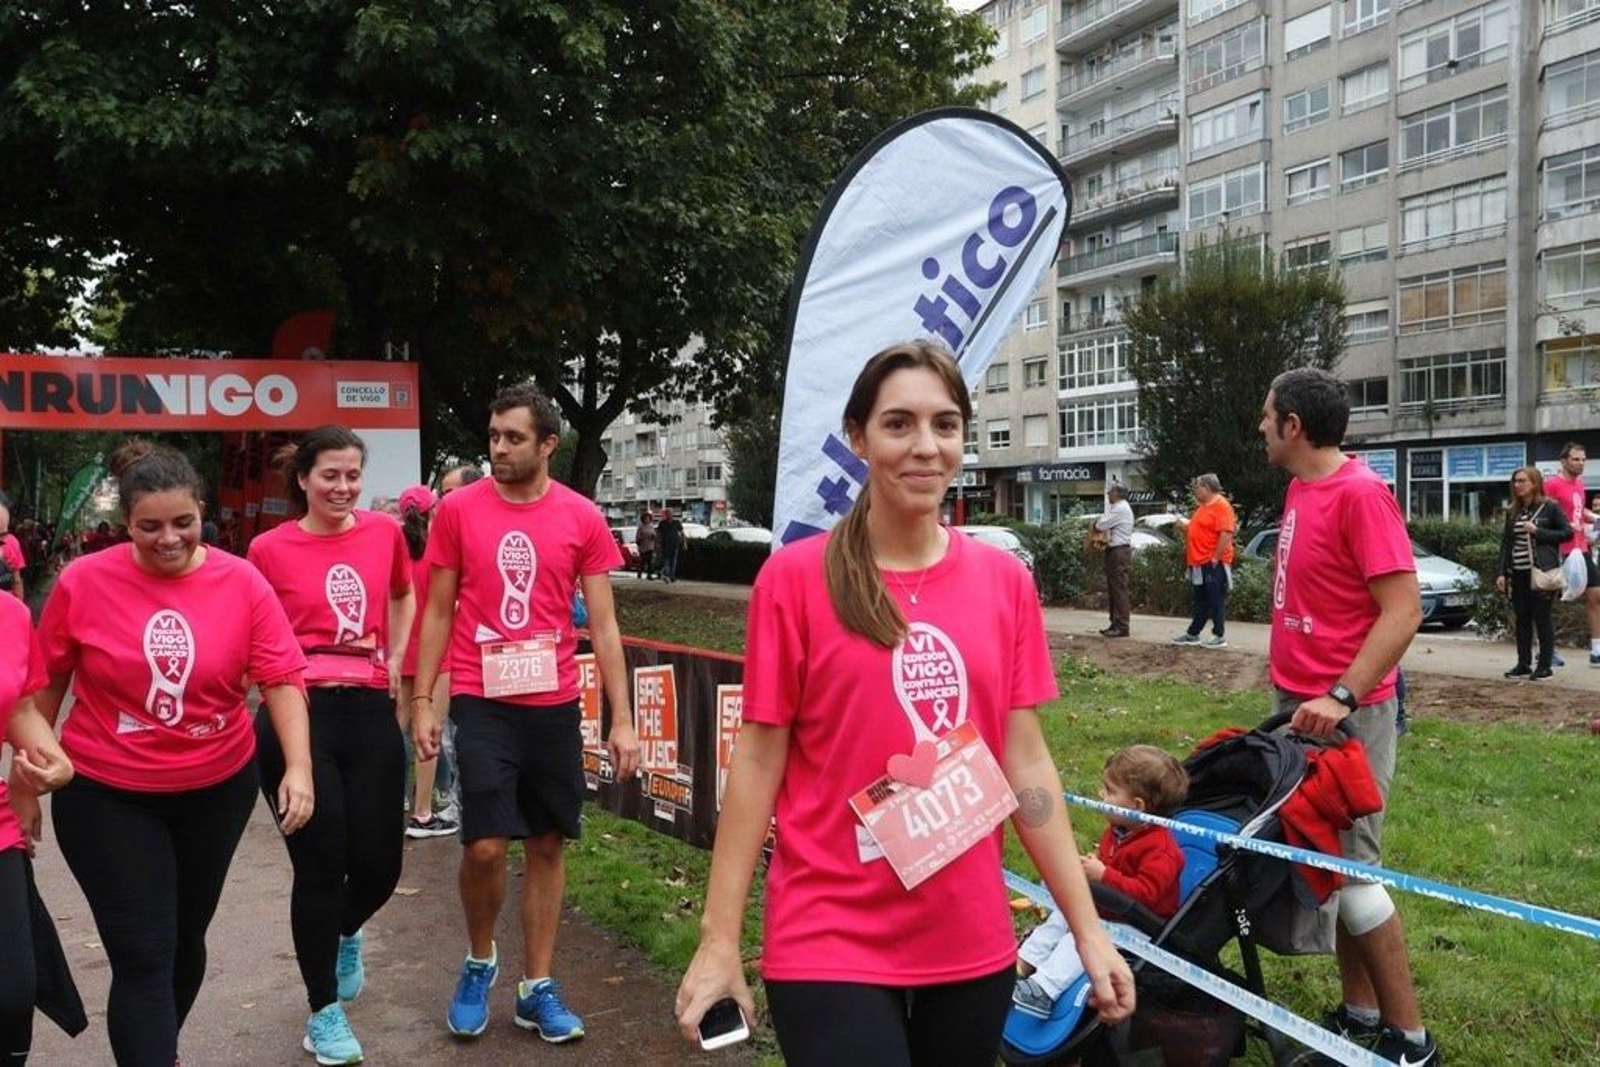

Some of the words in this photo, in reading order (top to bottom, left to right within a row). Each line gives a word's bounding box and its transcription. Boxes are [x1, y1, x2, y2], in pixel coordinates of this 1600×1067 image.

[340, 386, 386, 395] CONCELLO
[1038, 467, 1090, 481] farmacia
[158, 618, 176, 629] VI
[152, 635, 186, 644] VIGO
[908, 634, 935, 651] VI
[499, 656, 541, 680] 2376
[903, 660, 953, 679] VIGO
[904, 677, 944, 689] CONTRA
[945, 676, 958, 685] EL
[902, 764, 984, 838] 4073
